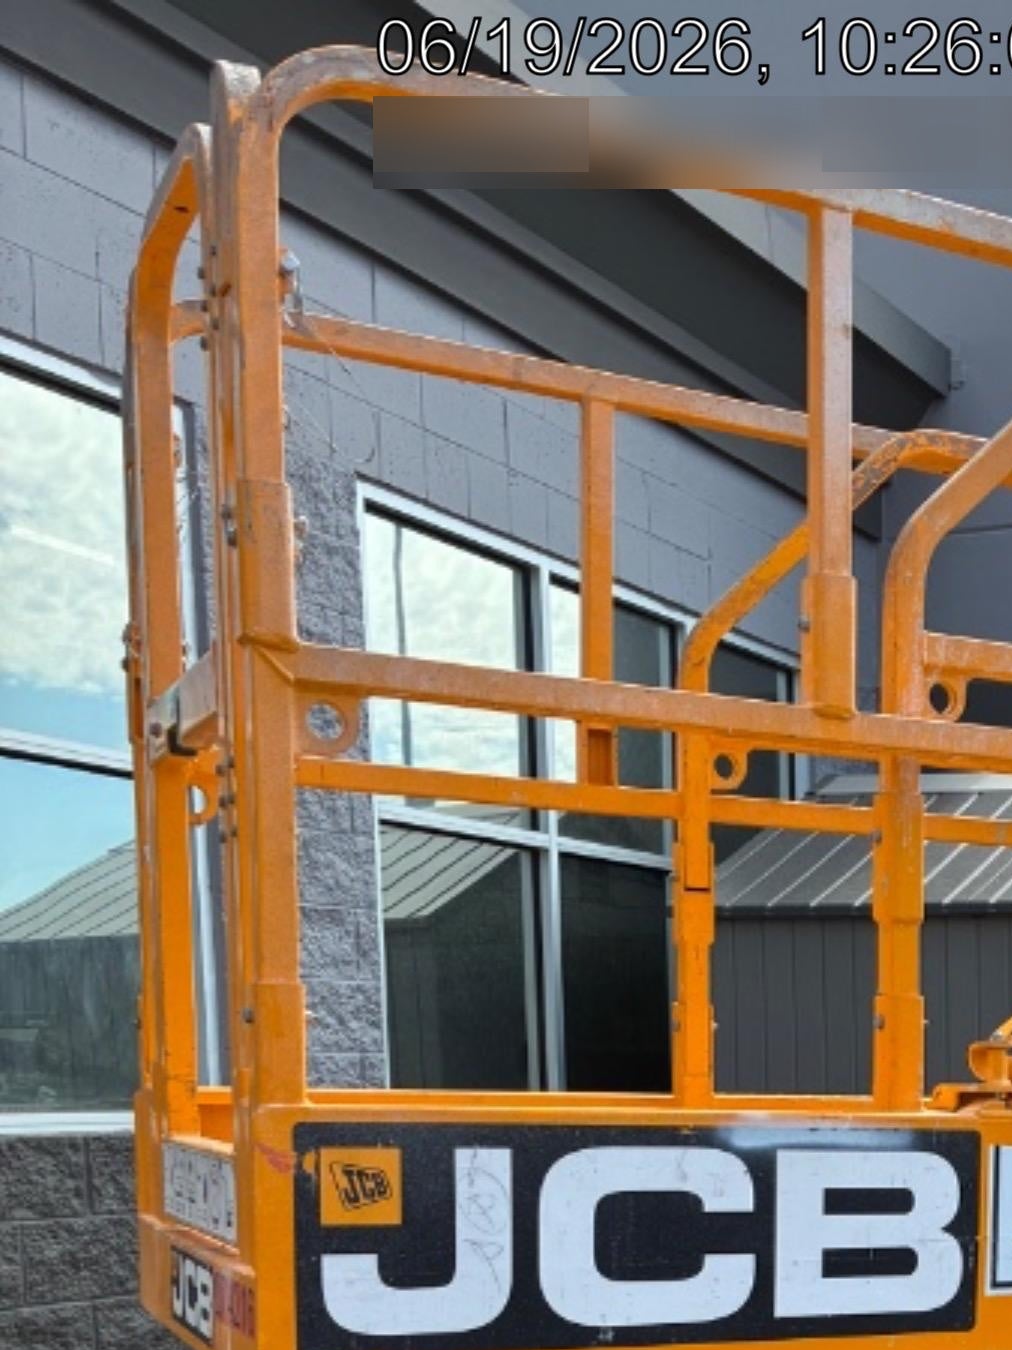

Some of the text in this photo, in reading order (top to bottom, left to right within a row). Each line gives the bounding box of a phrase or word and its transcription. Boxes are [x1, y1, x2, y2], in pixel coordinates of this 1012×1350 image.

[340, 1166, 388, 1204] JCB
[320, 1145, 964, 1335] JCB
[172, 1252, 214, 1339] JCB
